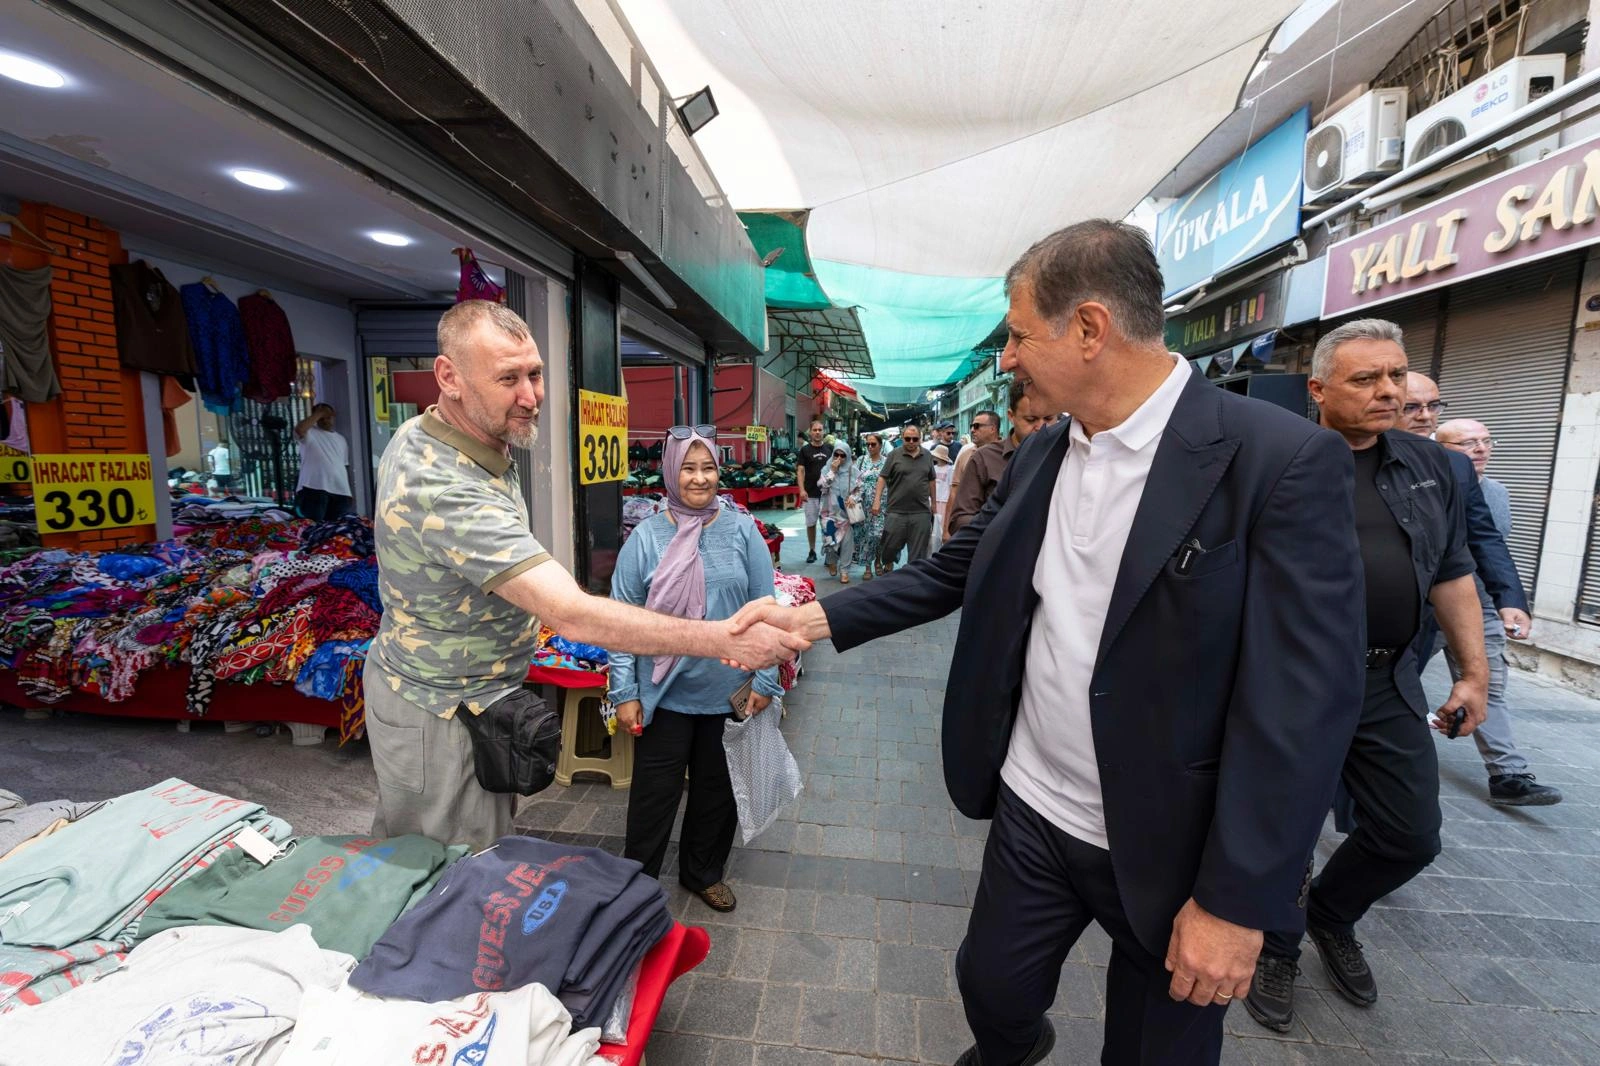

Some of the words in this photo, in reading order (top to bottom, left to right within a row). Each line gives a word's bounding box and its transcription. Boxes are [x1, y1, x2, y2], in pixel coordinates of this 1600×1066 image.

[1470, 92, 1509, 118] BEKO
[1351, 208, 1469, 295] YALI
[99, 461, 152, 481] FAZLASI
[472, 890, 522, 991] GUESS
